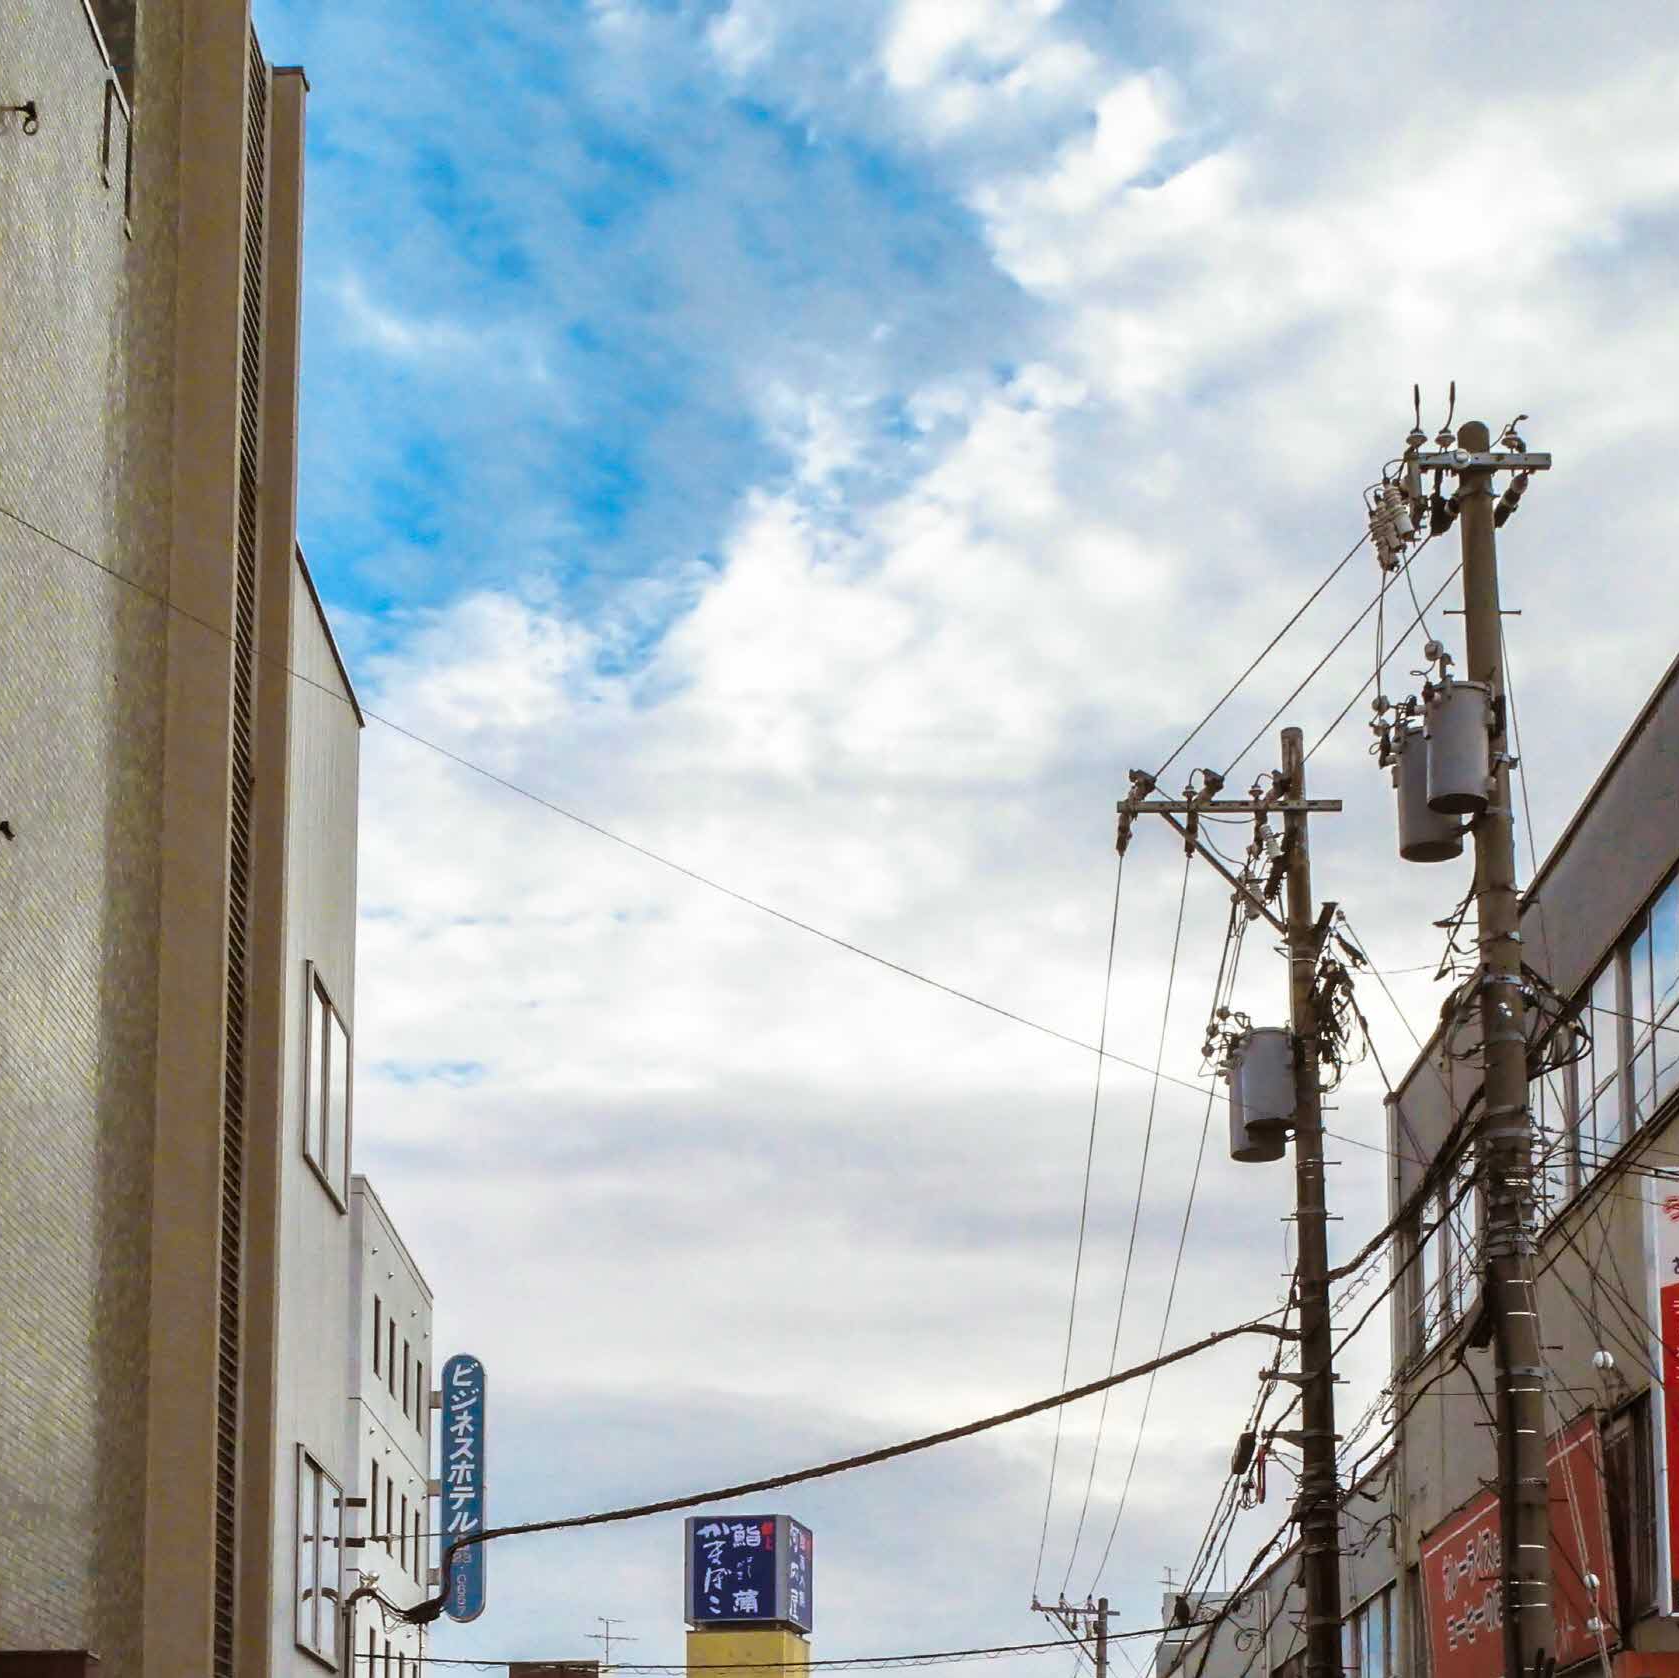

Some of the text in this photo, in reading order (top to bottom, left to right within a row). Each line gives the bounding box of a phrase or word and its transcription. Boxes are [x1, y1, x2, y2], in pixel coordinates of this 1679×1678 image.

[448, 1362, 480, 1533] ビジネスホテル
